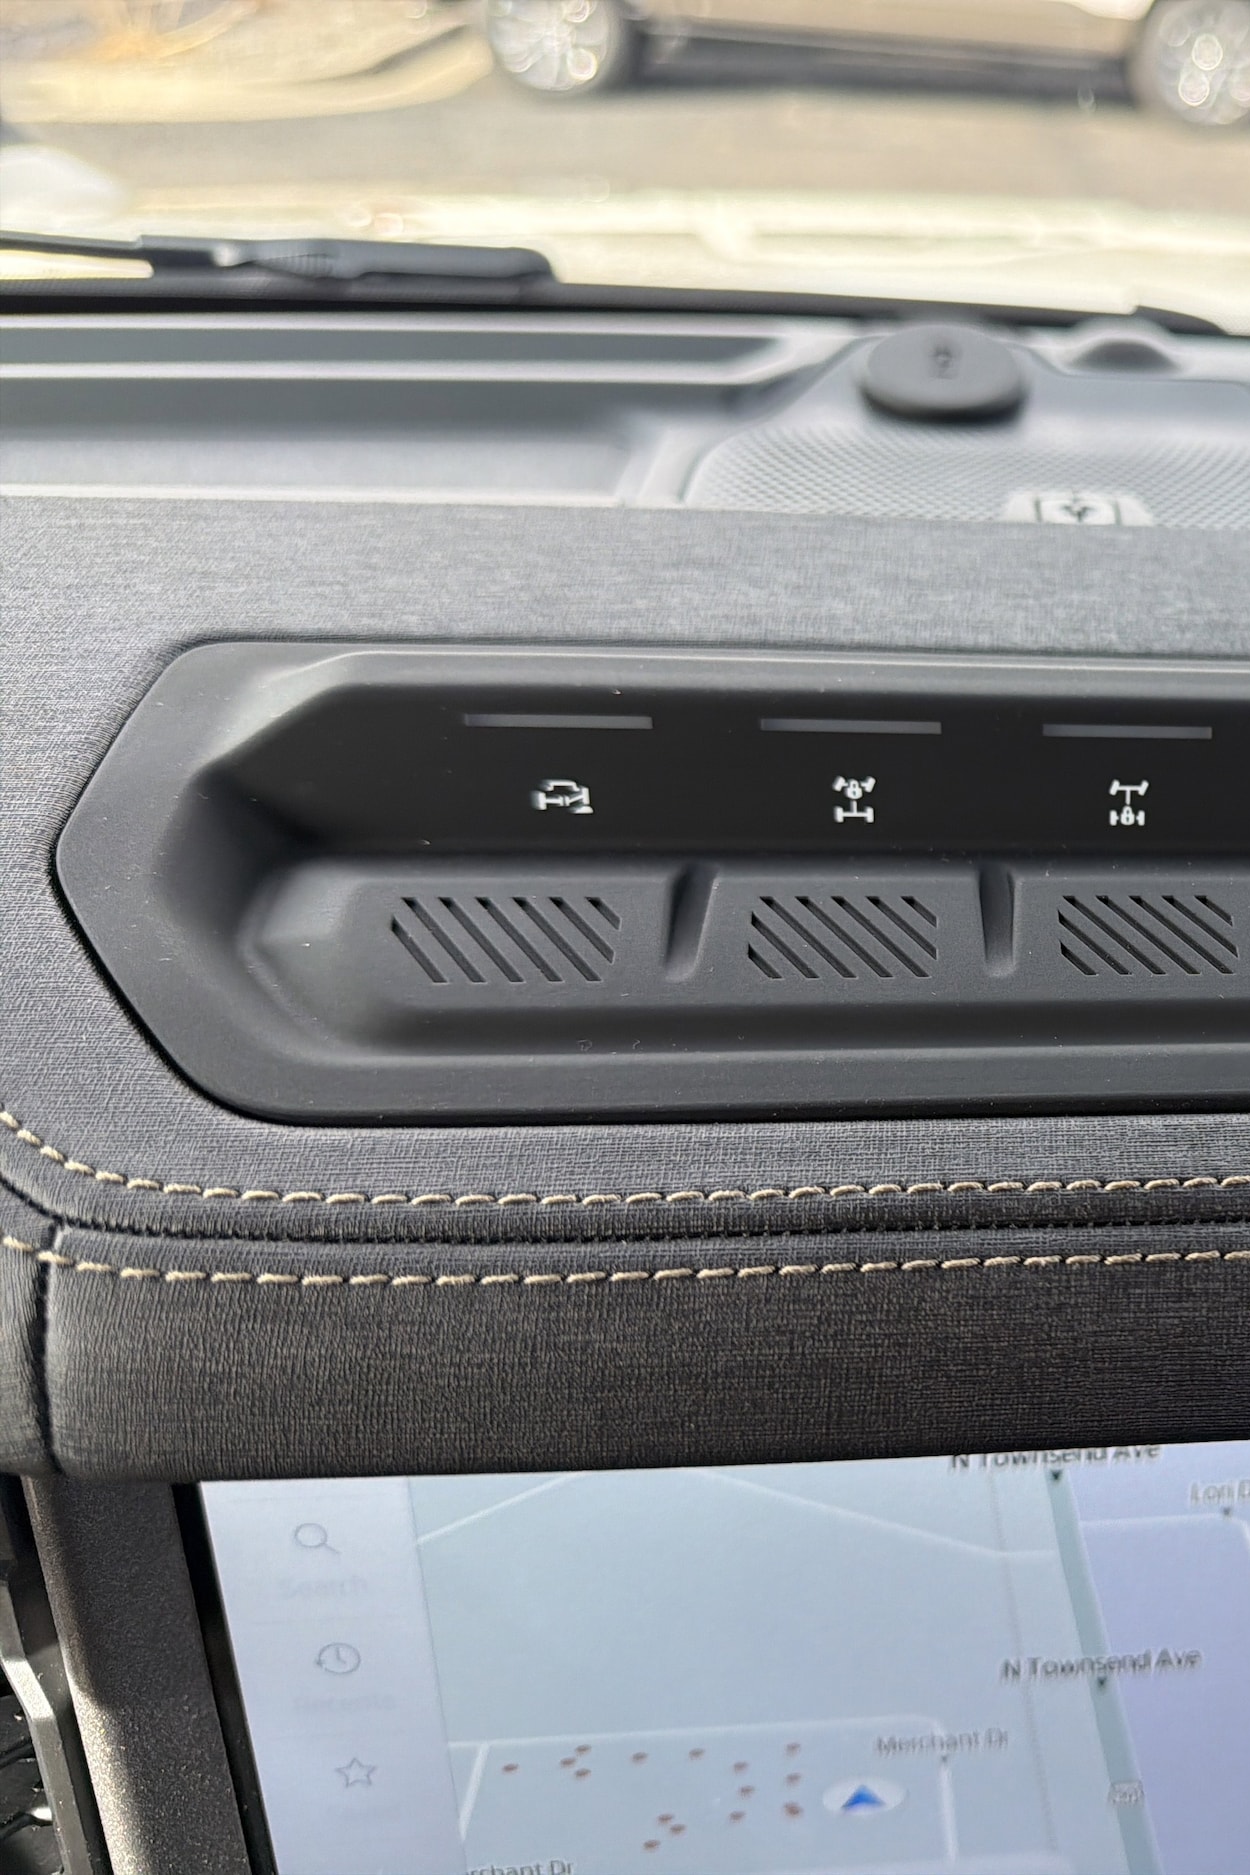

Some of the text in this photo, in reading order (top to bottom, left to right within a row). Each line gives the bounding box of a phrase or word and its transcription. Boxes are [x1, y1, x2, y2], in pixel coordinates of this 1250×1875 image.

[1004, 1648, 1202, 1679] N Townsend Ave
[876, 1728, 1008, 1756] Merchant Dr
